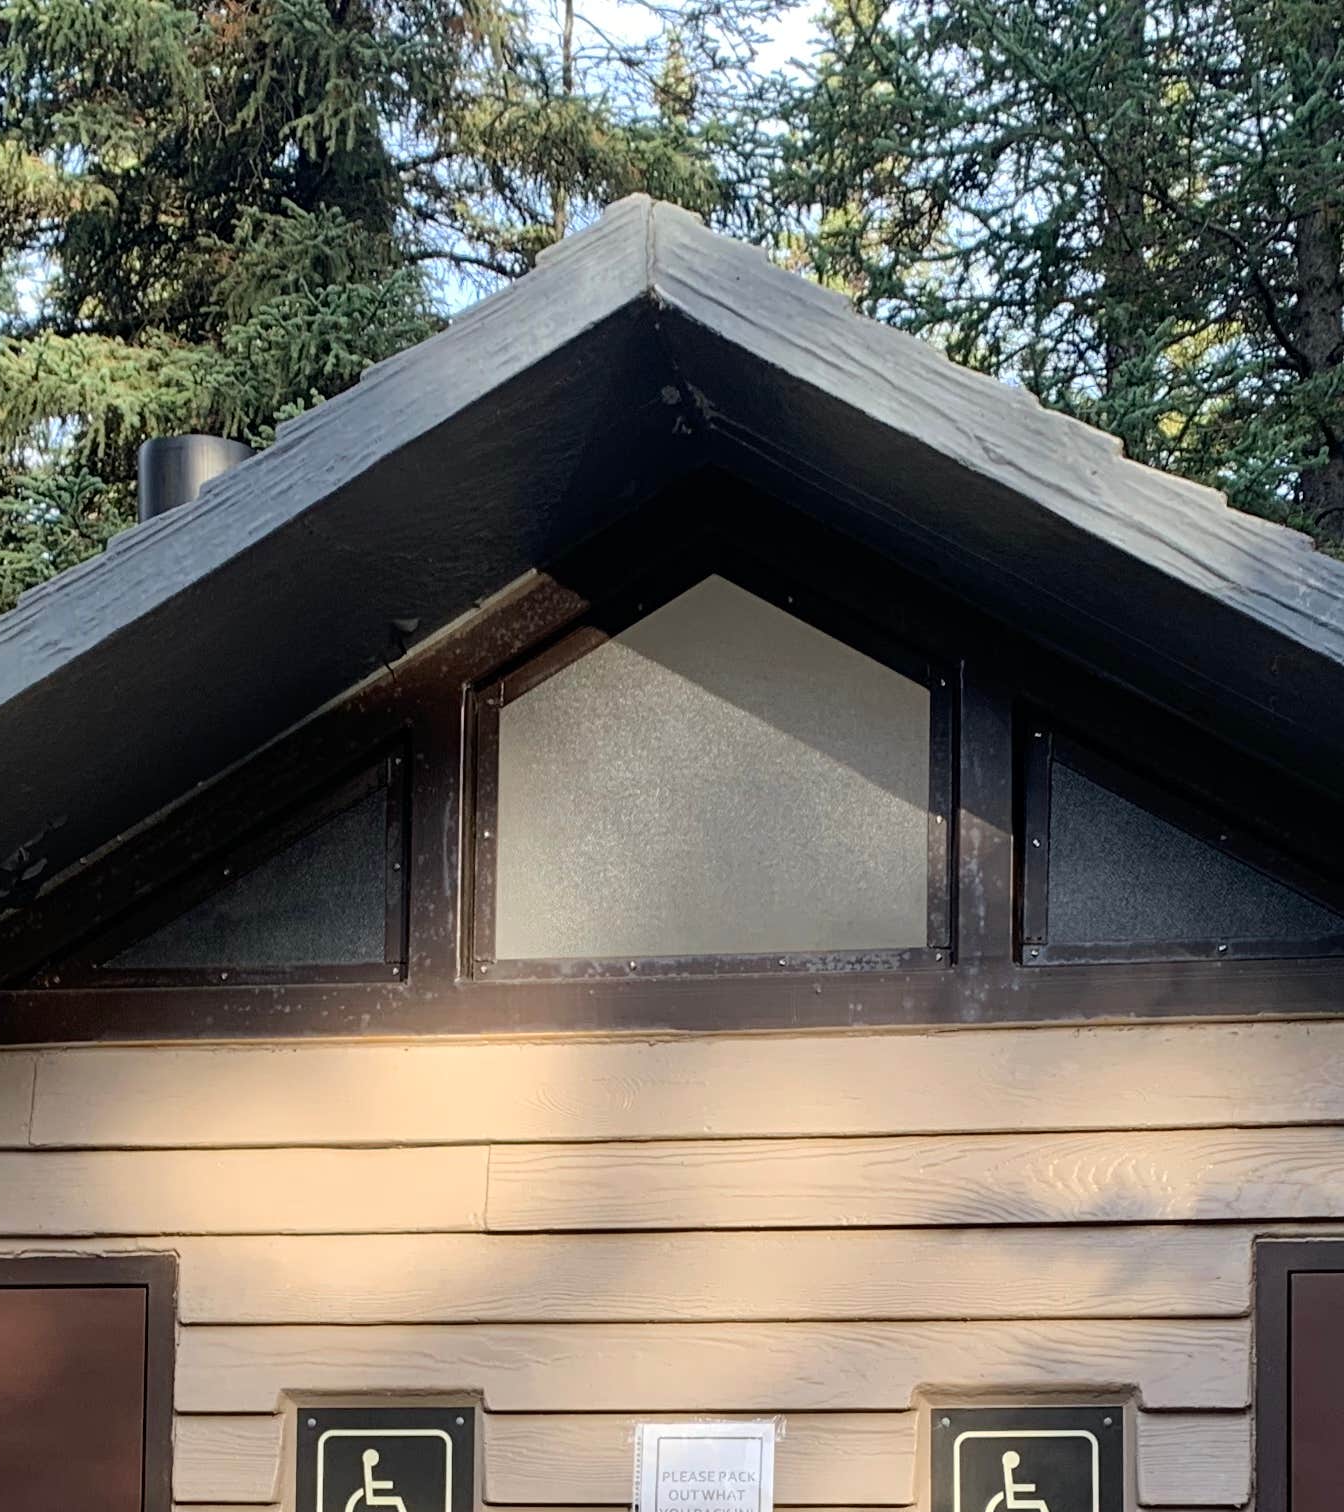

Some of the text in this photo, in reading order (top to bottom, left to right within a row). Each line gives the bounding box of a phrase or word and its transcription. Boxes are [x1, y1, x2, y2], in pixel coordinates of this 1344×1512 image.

[662, 1471, 756, 1483] PLEASE PACK
[668, 1489, 746, 1501] OUT WHAT
